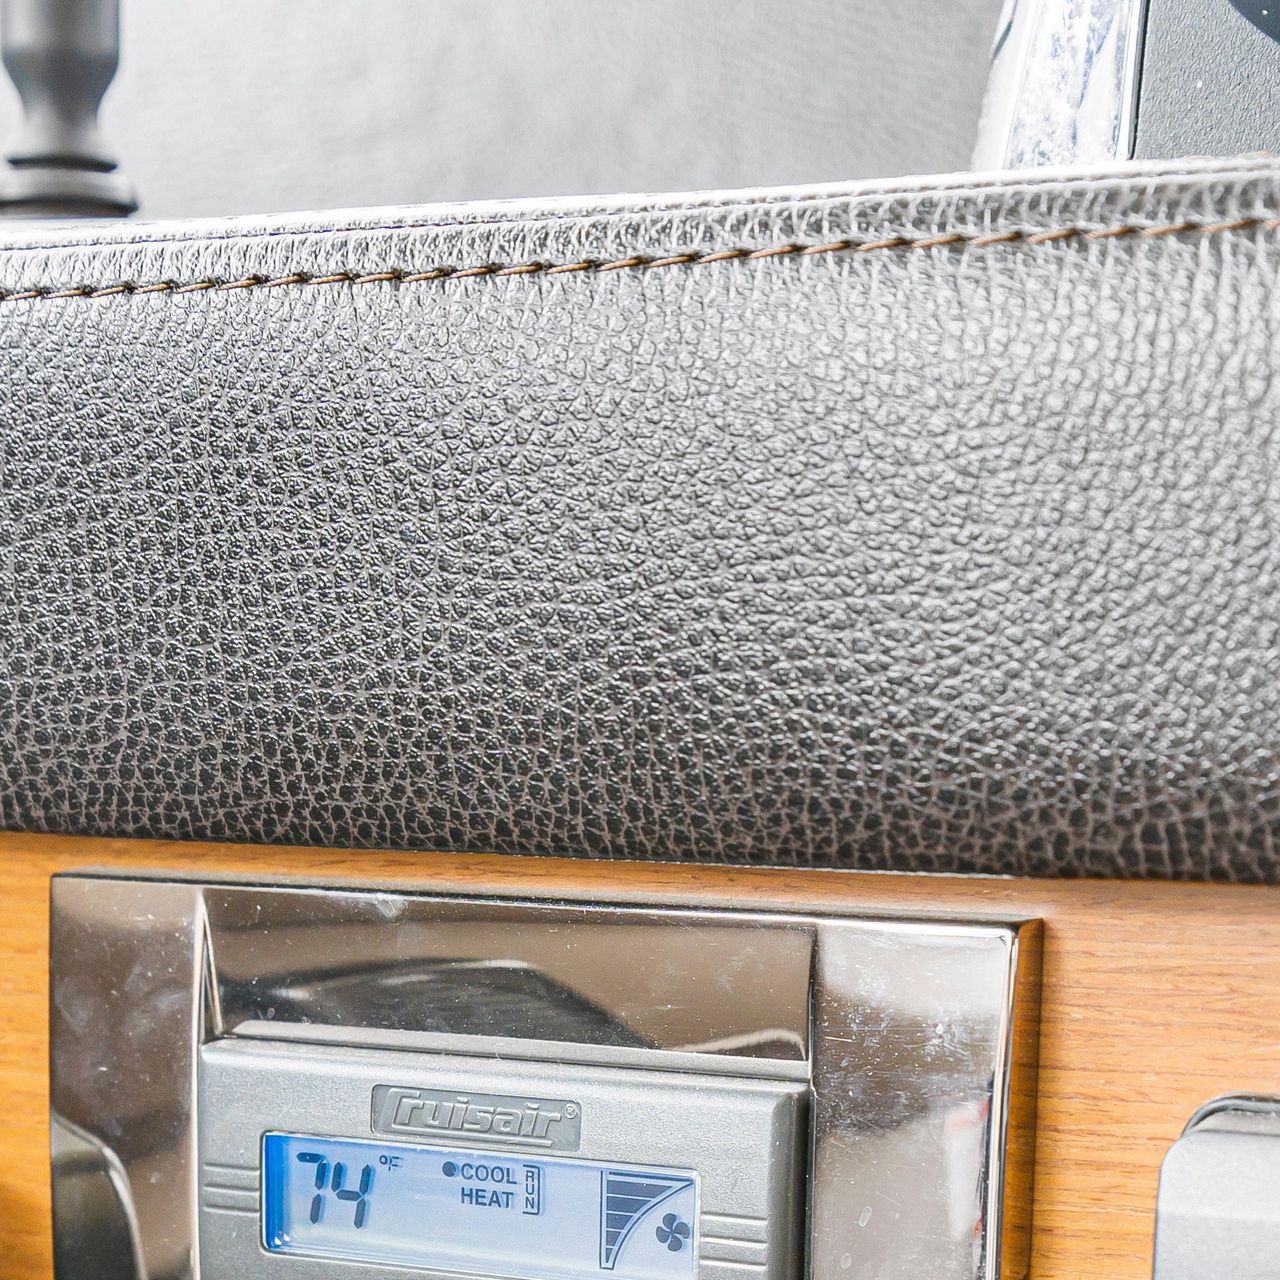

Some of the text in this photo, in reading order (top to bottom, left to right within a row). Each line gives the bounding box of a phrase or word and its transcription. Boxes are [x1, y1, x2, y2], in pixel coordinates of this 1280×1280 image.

[296, 1152, 372, 1229] 74
[460, 1163, 518, 1186] COOL
[524, 1169, 536, 1210] RUN
[460, 1186, 515, 1209] HEAT
